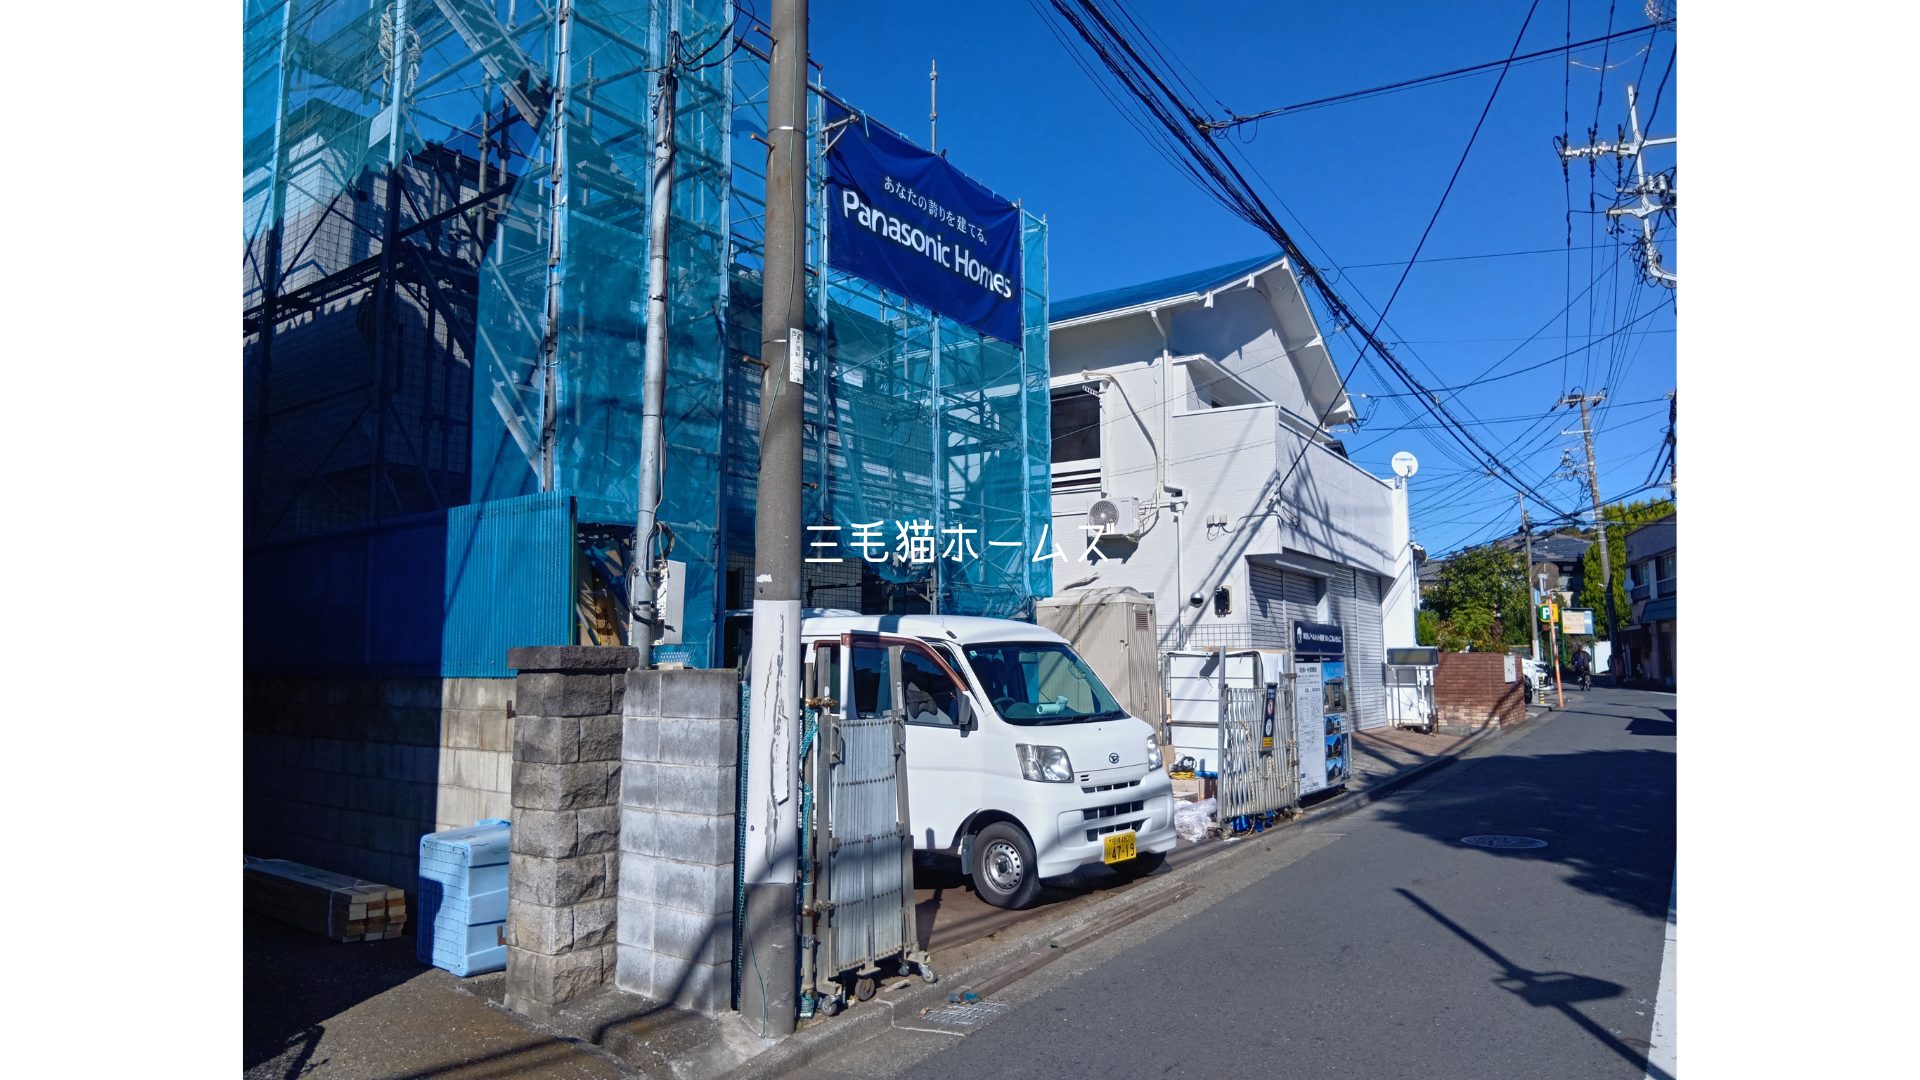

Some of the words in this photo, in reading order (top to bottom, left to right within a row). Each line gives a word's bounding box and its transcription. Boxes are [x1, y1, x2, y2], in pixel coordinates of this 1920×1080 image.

[884, 176, 988, 246] あなたの誇りを建てる。
[842, 188, 951, 269] Panasonic
[954, 244, 1013, 299] Homes
[1542, 607, 1551, 620] P
[1112, 842, 1134, 860] 47-19
